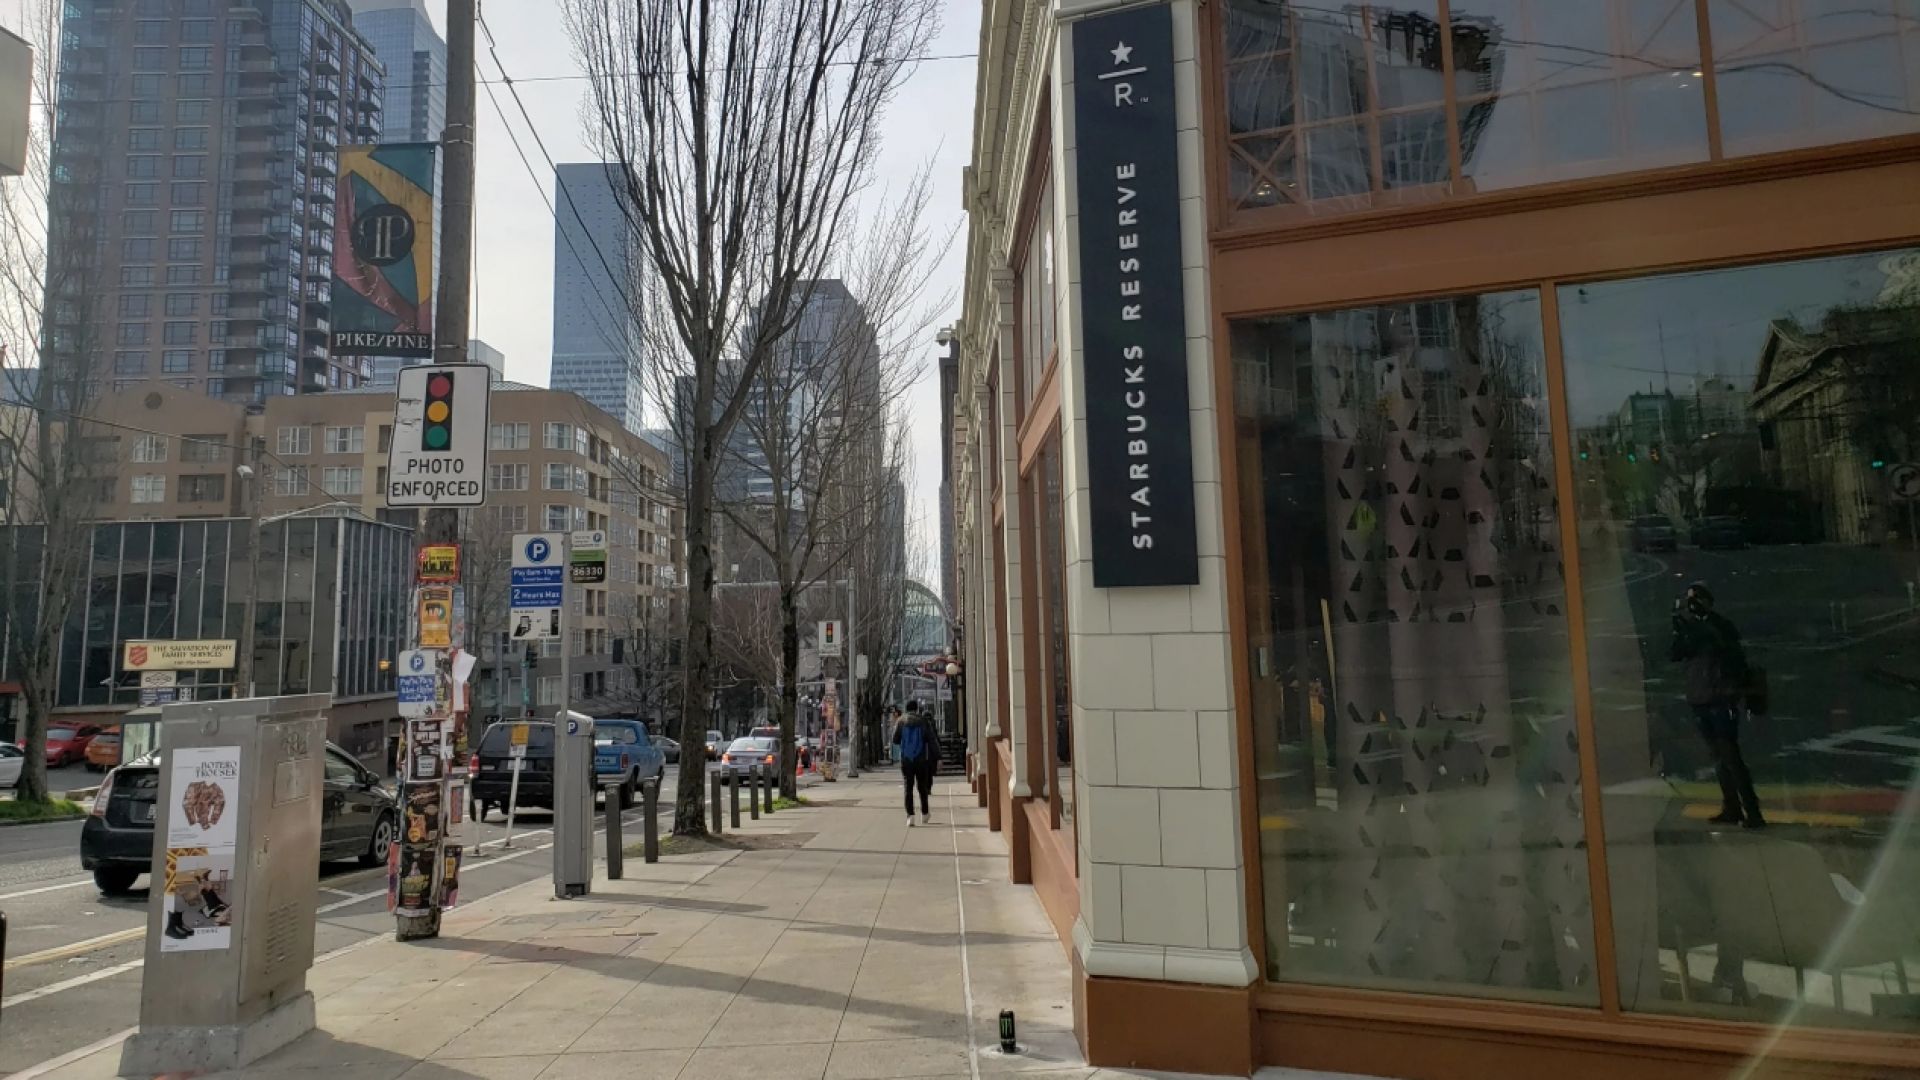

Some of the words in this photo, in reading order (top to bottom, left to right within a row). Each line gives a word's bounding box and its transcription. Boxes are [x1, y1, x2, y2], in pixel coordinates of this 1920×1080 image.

[1115, 83, 1133, 107] R
[1116, 162, 1142, 321] RESERVE
[336, 333, 429, 350] PIKE/PINE
[1123, 344, 1153, 550] STARBUCKS
[407, 458, 464, 475] PHOTO
[392, 480, 479, 498] ENFORCED
[532, 543, 546, 559] P
[513, 588, 521, 600] 2
[567, 721, 576, 733] P
